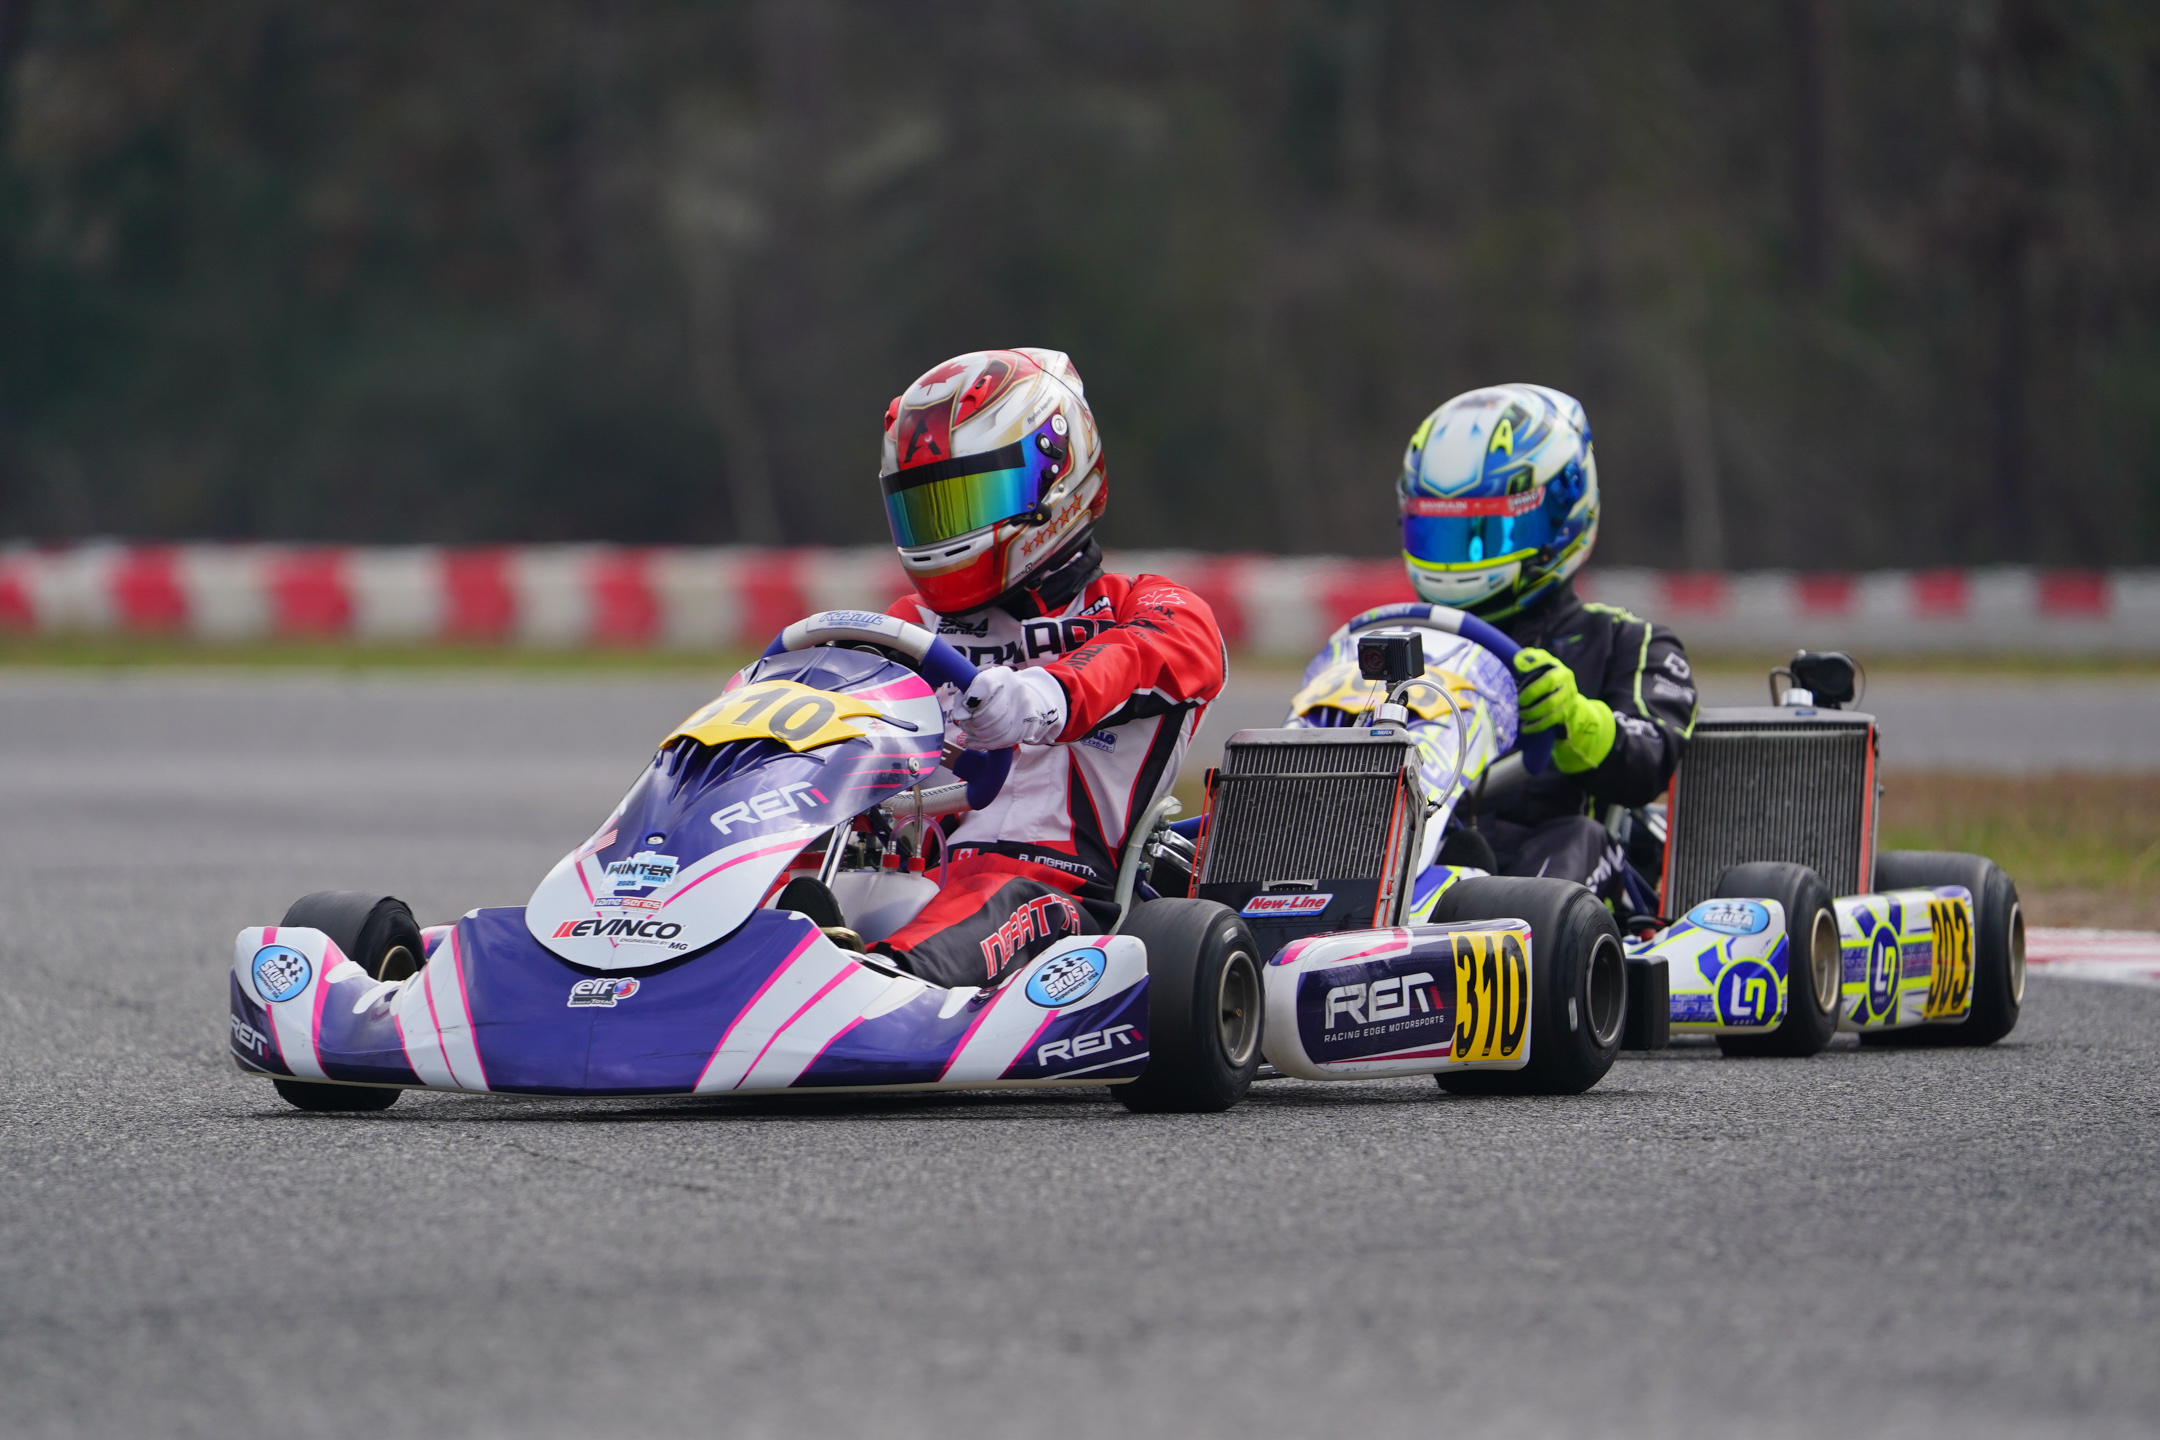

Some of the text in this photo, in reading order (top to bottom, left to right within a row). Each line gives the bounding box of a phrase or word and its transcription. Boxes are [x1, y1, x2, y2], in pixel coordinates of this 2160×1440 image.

[937, 627, 988, 638] Karting
[609, 862, 675, 878] WINTER
[1034, 856, 1097, 878] INGRATTA
[643, 875, 667, 883] SERIES
[621, 898, 661, 910] series
[1247, 896, 1327, 910] New-Line
[668, 942, 689, 951] MG
[1927, 901, 1971, 1013] 303
[260, 959, 293, 995] SKUSA
[1044, 960, 1096, 999] SKUSA
[575, 980, 617, 995] elf
[1456, 934, 1529, 1059] 310
[1324, 1014, 1445, 1043] RACING EDGE MOTORSPORTS
